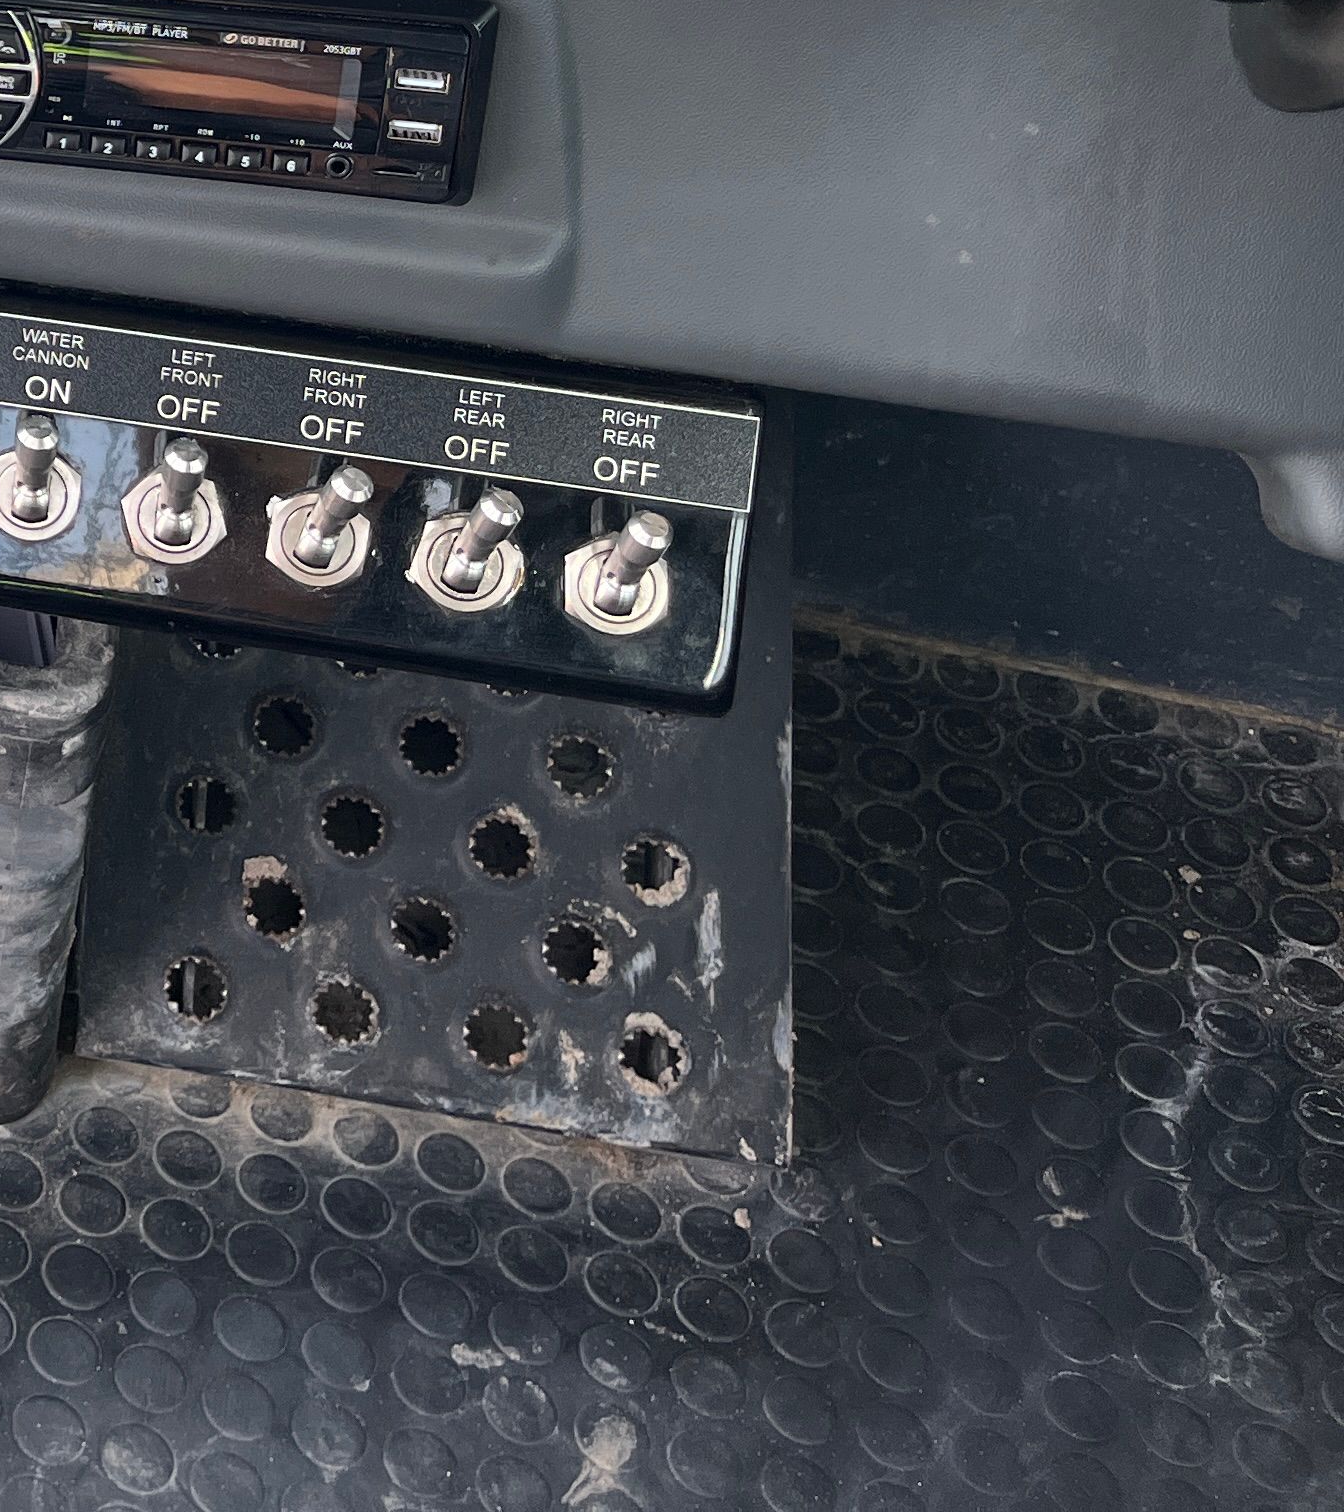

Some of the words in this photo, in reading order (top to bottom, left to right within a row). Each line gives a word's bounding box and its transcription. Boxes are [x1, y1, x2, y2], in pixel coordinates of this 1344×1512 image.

[92, 21, 147, 35] MP3/FM/BT
[152, 26, 189, 39] PLAYER
[240, 35, 257, 46] GO
[257, 37, 298, 49] BETTER
[59, 137, 67, 149] 1
[103, 143, 113, 155] 2
[148, 145, 158, 158] 3
[332, 141, 353, 150] AUX
[194, 151, 204, 163] 4
[240, 156, 250, 168] 5
[286, 160, 296, 172] 6
[21, 327, 86, 352] WATER
[11, 345, 91, 370] CANNON
[169, 349, 218, 370] LEFT
[159, 365, 224, 390] FRONT
[307, 368, 368, 392] RIGHT
[23, 374, 74, 405] ON
[301, 386, 368, 410] FRONT
[458, 388, 507, 409] LEFT
[155, 393, 222, 424] OFF
[452, 405, 507, 430] REAR
[601, 408, 663, 432] RIGHT
[299, 413, 365, 445] OFF
[601, 427, 658, 450] REAR
[443, 434, 510, 465] OFF
[593, 454, 661, 486] OFF
